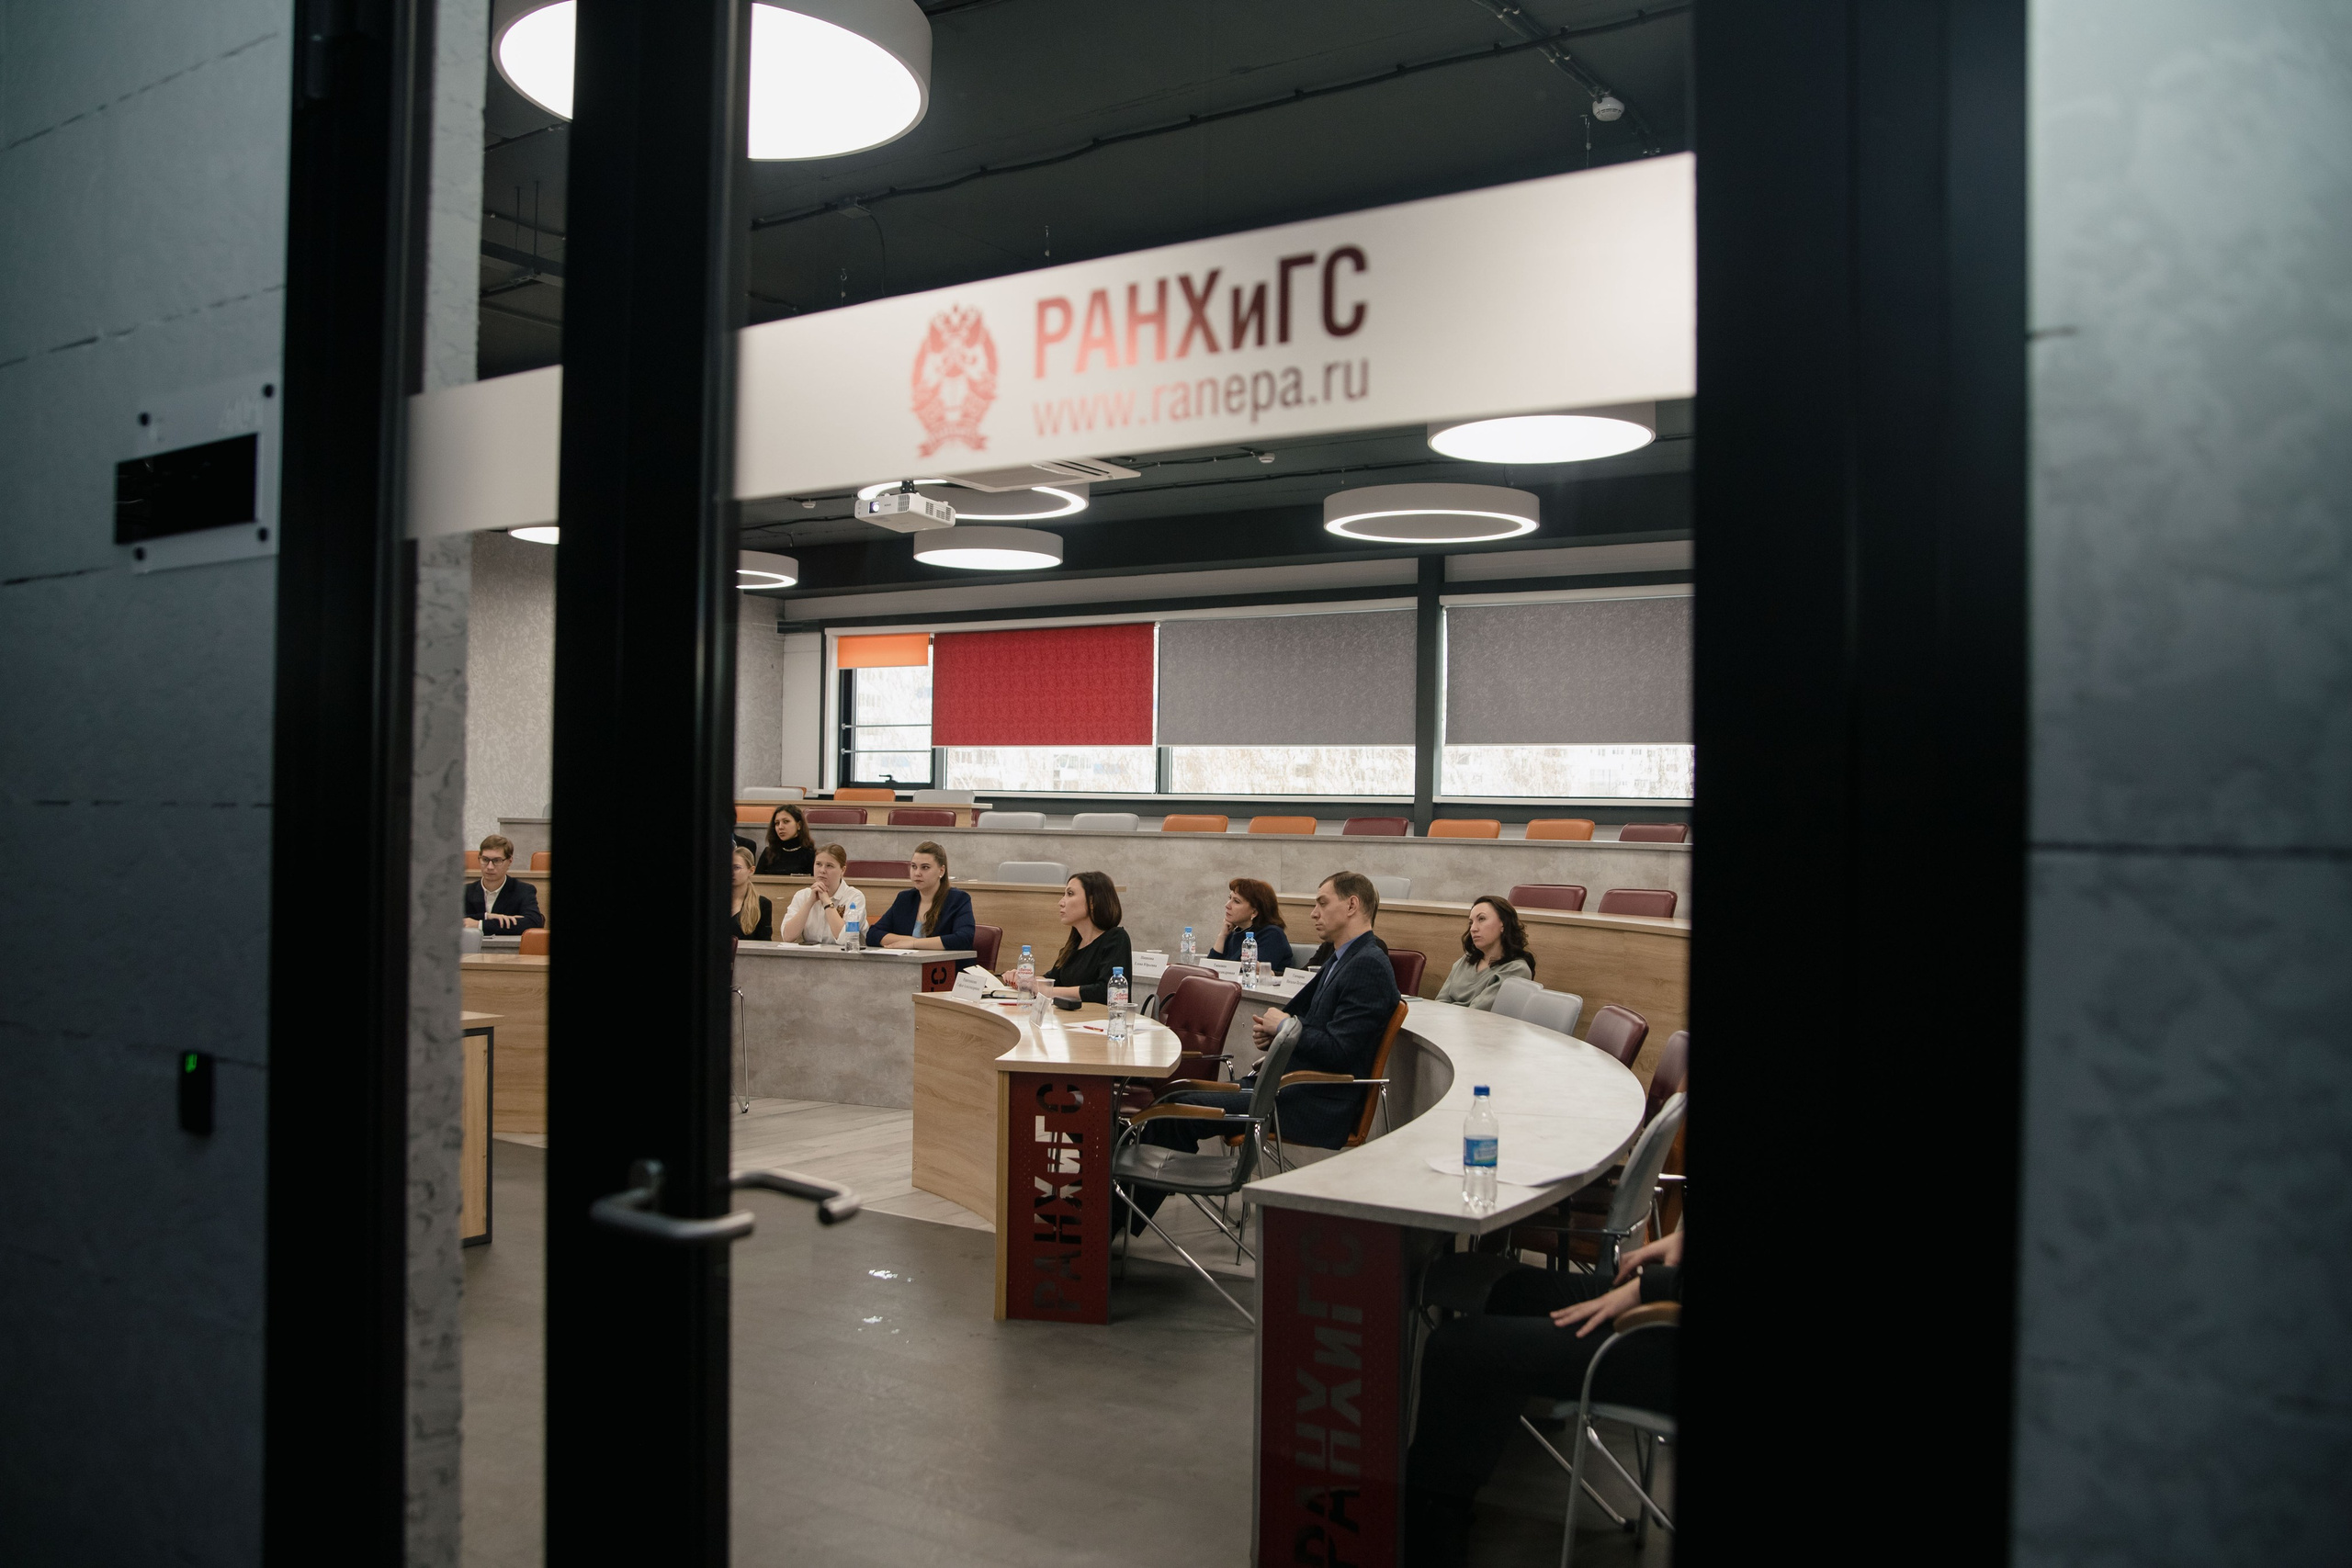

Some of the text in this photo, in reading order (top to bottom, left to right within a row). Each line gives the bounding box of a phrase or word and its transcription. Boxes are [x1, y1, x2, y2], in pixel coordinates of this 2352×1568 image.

[1033, 243, 1369, 380] РАНХиГС
[1033, 356, 1370, 437] www.ranepa.ru
[1033, 1082, 1085, 1312] РАНХиГС
[1295, 1223, 1364, 1568] РАНХиГС
